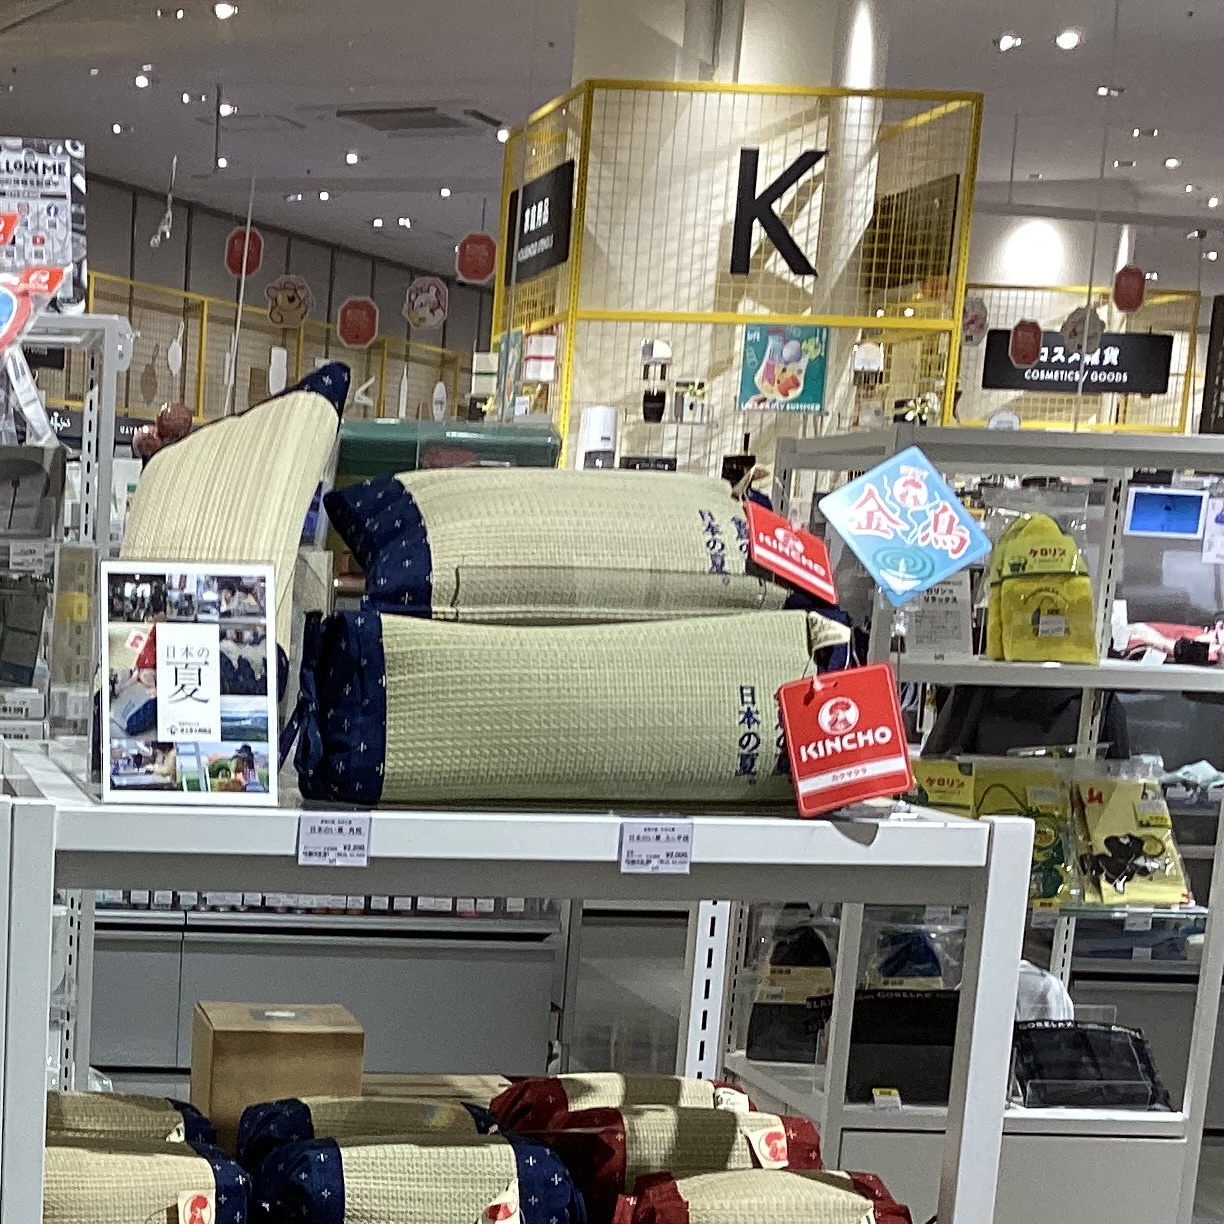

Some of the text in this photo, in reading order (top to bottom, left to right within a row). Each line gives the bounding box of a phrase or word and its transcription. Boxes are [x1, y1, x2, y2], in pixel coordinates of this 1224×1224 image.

[730, 148, 829, 277] K
[1090, 371, 1128, 382] GOODS
[167, 644, 210, 660] 日本の
[166, 661, 209, 704] 夏
[800, 726, 892, 763] KINCHO
